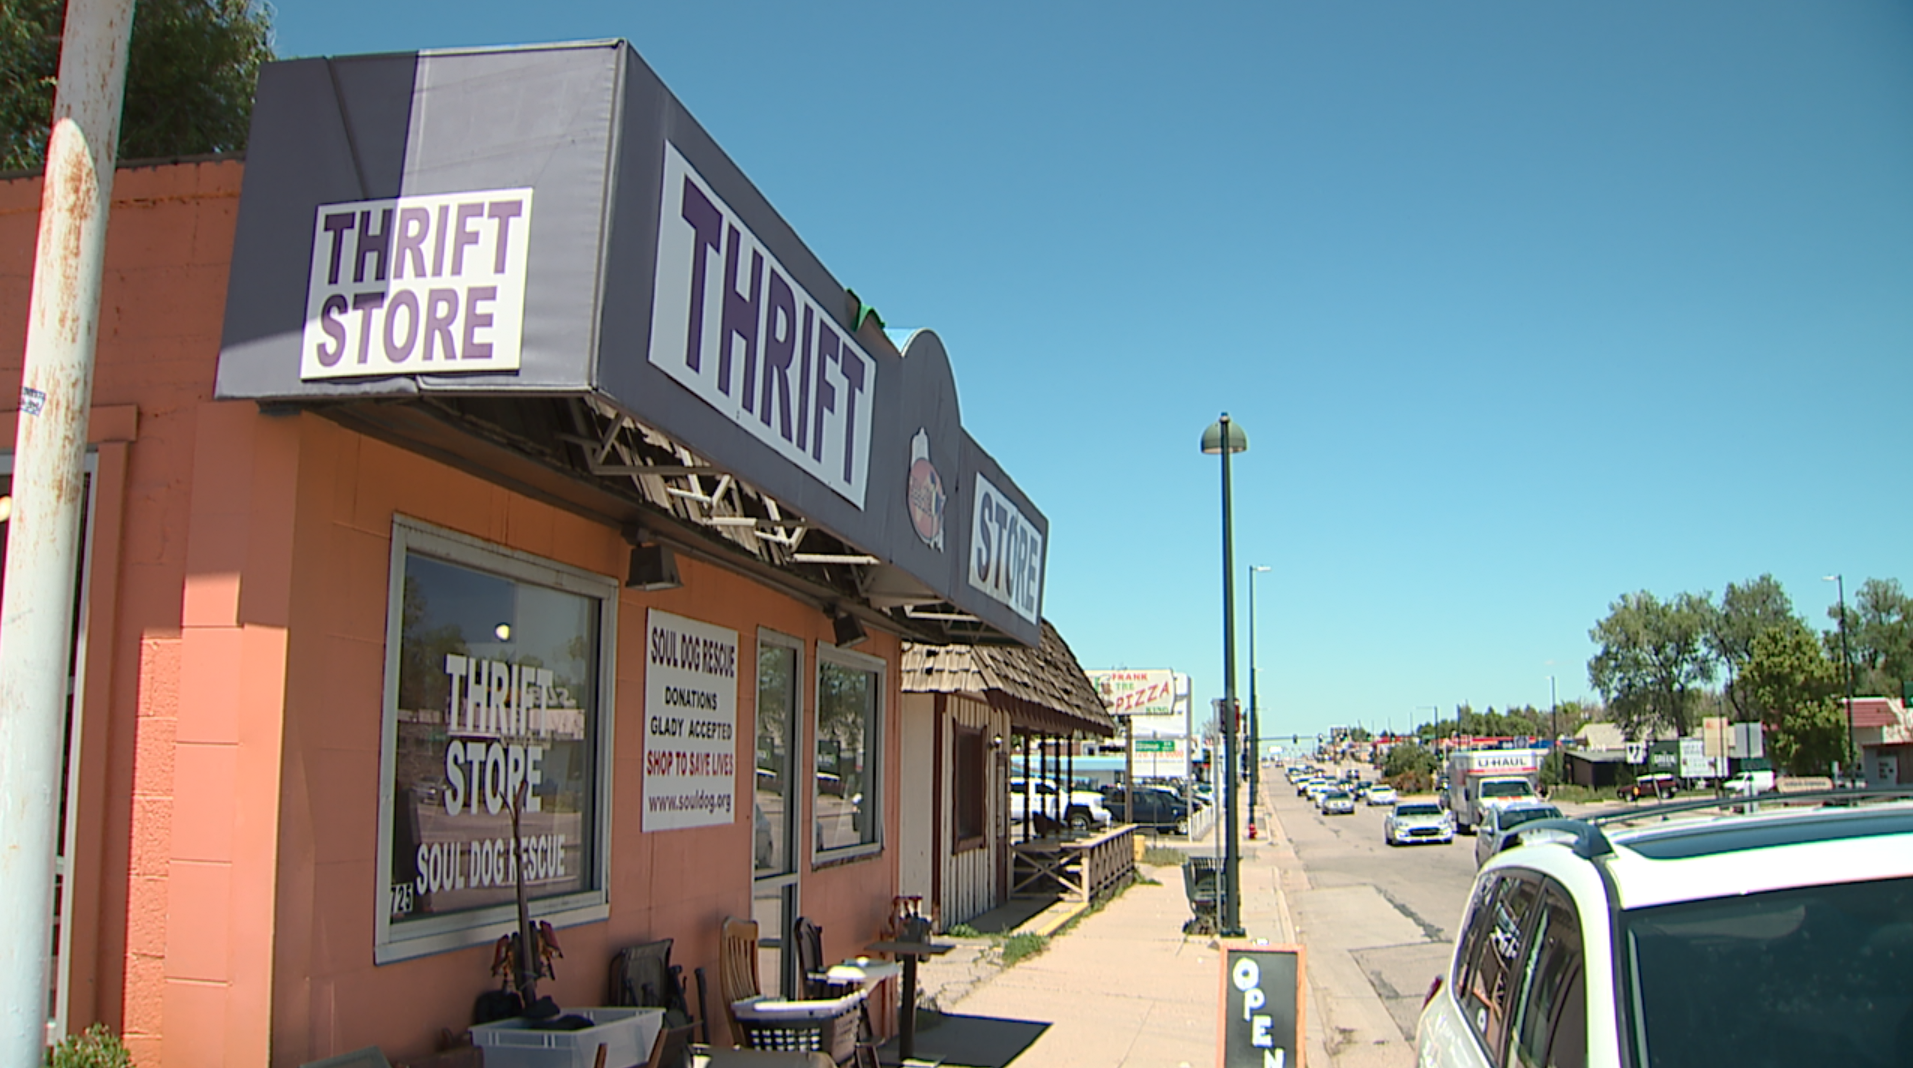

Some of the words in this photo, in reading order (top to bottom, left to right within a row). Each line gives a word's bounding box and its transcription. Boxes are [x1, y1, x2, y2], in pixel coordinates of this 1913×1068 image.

[323, 200, 523, 285] THRIFT
[317, 285, 497, 367] STORE
[681, 173, 866, 485] THRIFT
[975, 491, 1039, 613] STORE
[651, 626, 678, 668] SOUL
[681, 633, 700, 672] DOG
[702, 639, 735, 678] RESCUE
[1112, 673, 1148, 681] FRANK
[445, 653, 554, 739] THRIFT
[665, 685, 718, 711] DONATIONS
[1115, 681, 1169, 714] PIZZA
[651, 715, 684, 737] GLADY
[688, 719, 732, 740] ACCEPTED
[444, 739, 543, 816] STORE
[647, 749, 673, 776] SHOP
[675, 750, 688, 776] TO
[689, 750, 710, 776] SAVE
[712, 752, 733, 776] LIVES
[648, 788, 731, 814] www.souldog.org
[416, 842, 465, 896] SOUL
[470, 838, 504, 888] DOG
[508, 834, 566, 882] RESCUE
[1232, 957, 1284, 1068] OPEN
